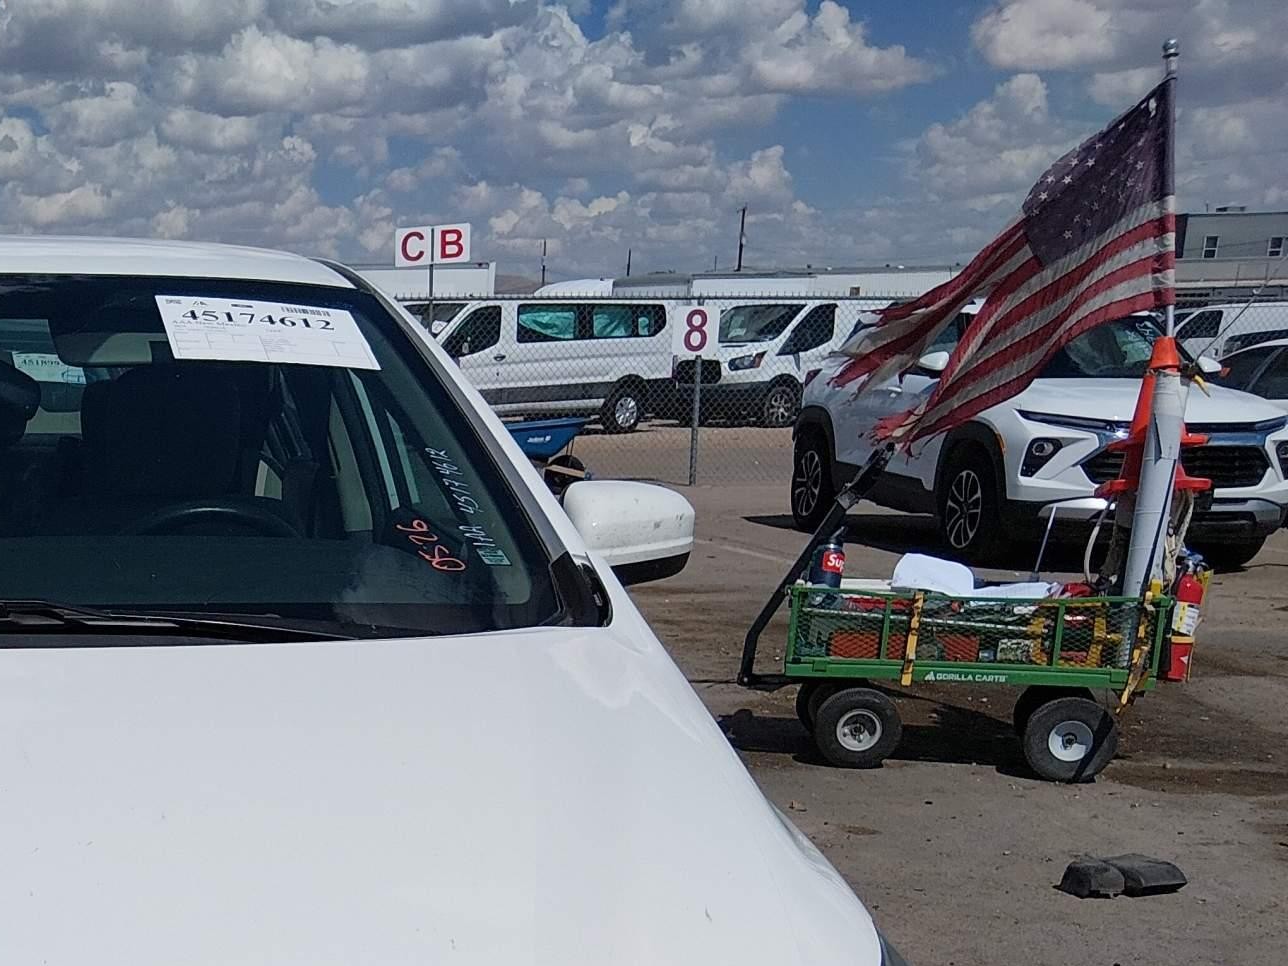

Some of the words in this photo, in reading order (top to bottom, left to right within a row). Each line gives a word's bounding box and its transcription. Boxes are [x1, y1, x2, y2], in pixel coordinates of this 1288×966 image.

[401, 231, 425, 262] C
[440, 229, 464, 259] B
[182, 309, 335, 331] 45174612
[684, 309, 708, 352] 8
[936, 672, 974, 682] GORILLA
